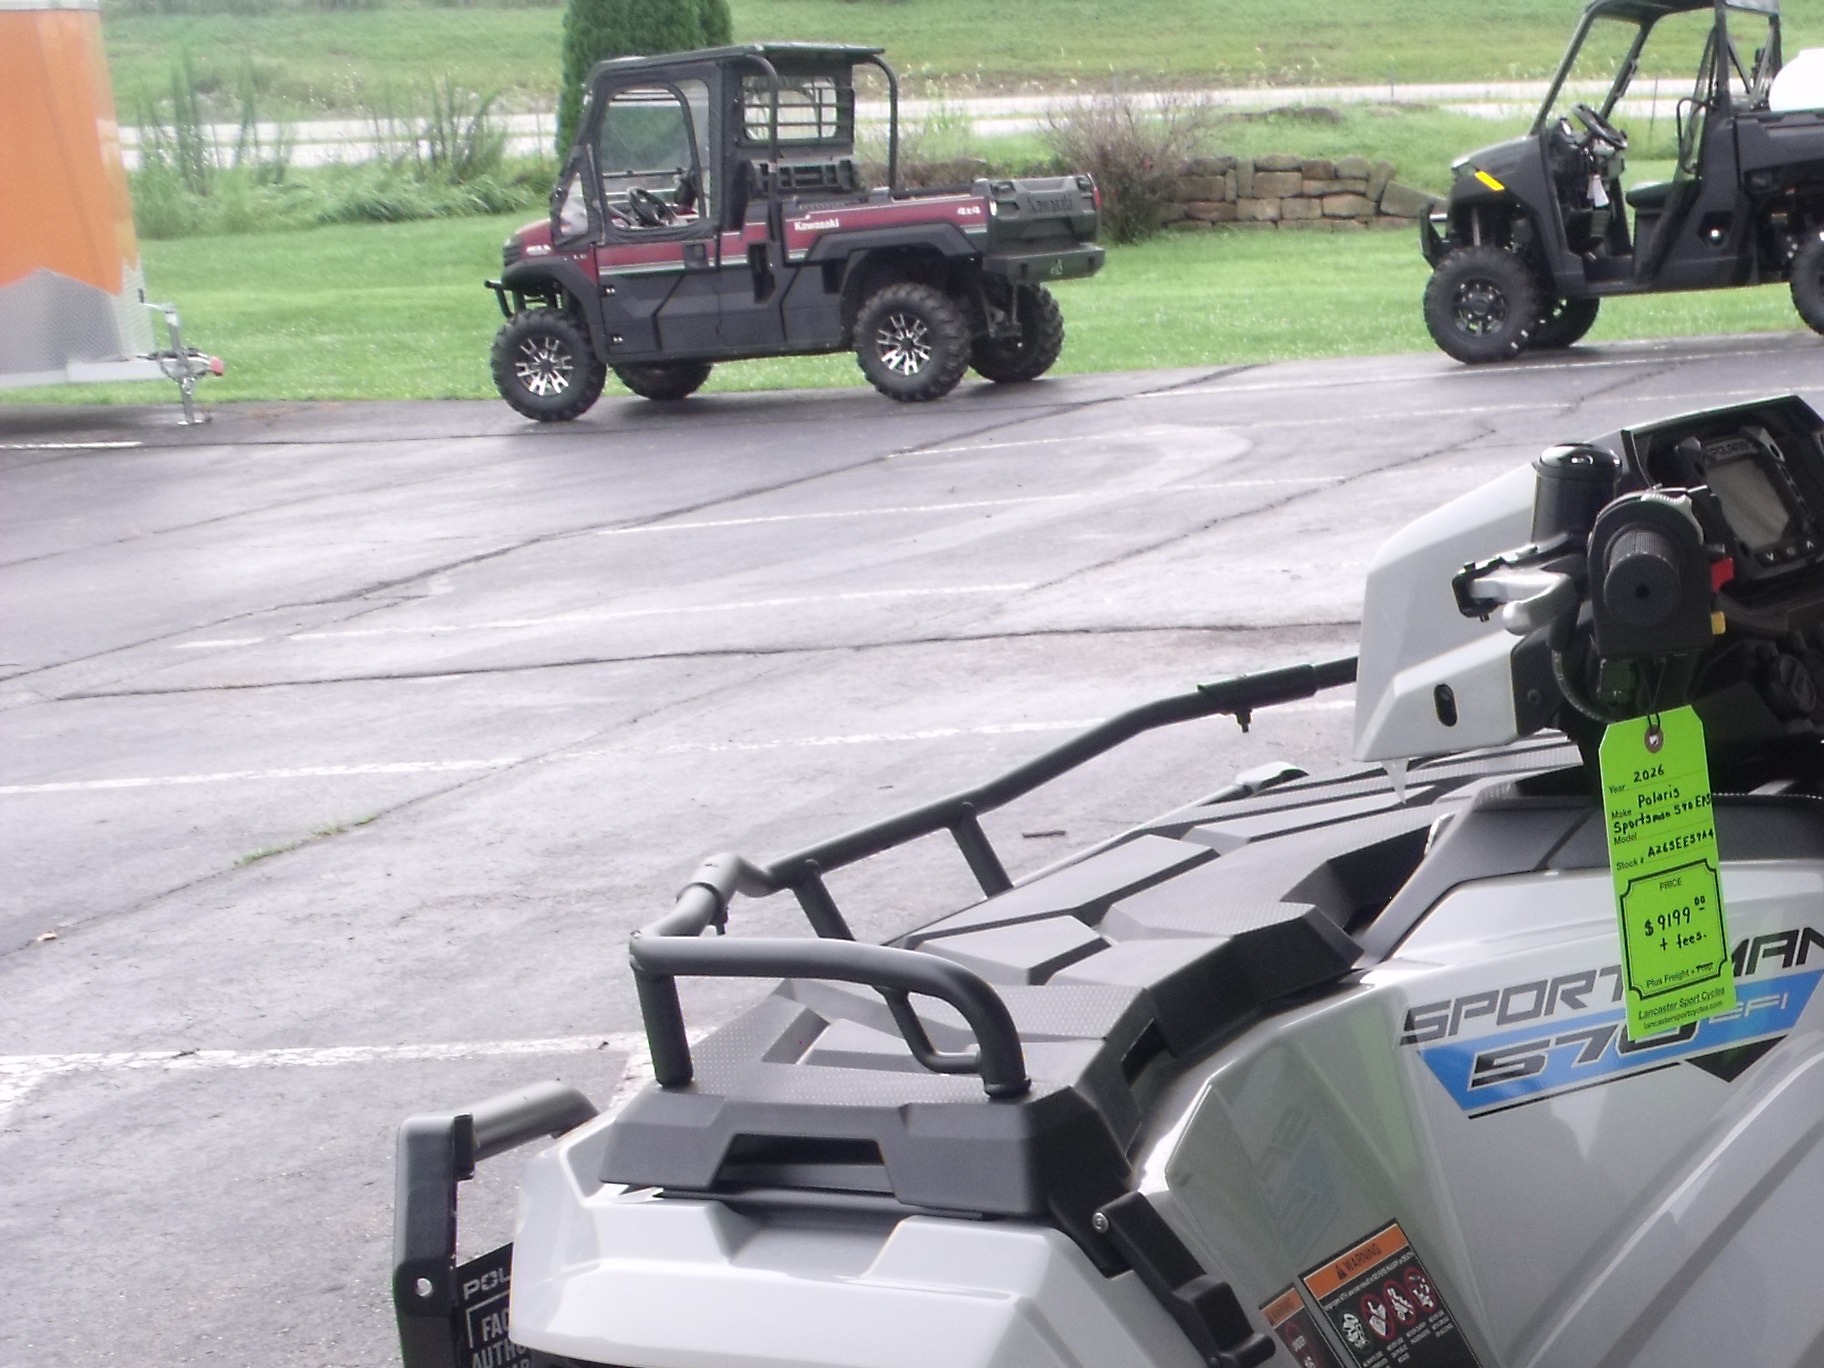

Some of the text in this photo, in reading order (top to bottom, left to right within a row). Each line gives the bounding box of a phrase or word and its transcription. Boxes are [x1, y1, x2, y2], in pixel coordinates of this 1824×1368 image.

[957, 206, 981, 215] 4x4
[794, 218, 840, 231] Kawasaki
[1633, 764, 1664, 783] 2026
[1637, 784, 1680, 809] Polaris
[1613, 812, 1671, 834] Sportsman
[1616, 858, 1638, 871] Stock
[1660, 877, 1682, 891] PRICE
[1647, 976, 1662, 988] Plus
[1664, 968, 1690, 984] Freight
[1638, 987, 1725, 1020] Lancaster Sport Cycles
[1345, 1243, 1382, 1275] WARNING
